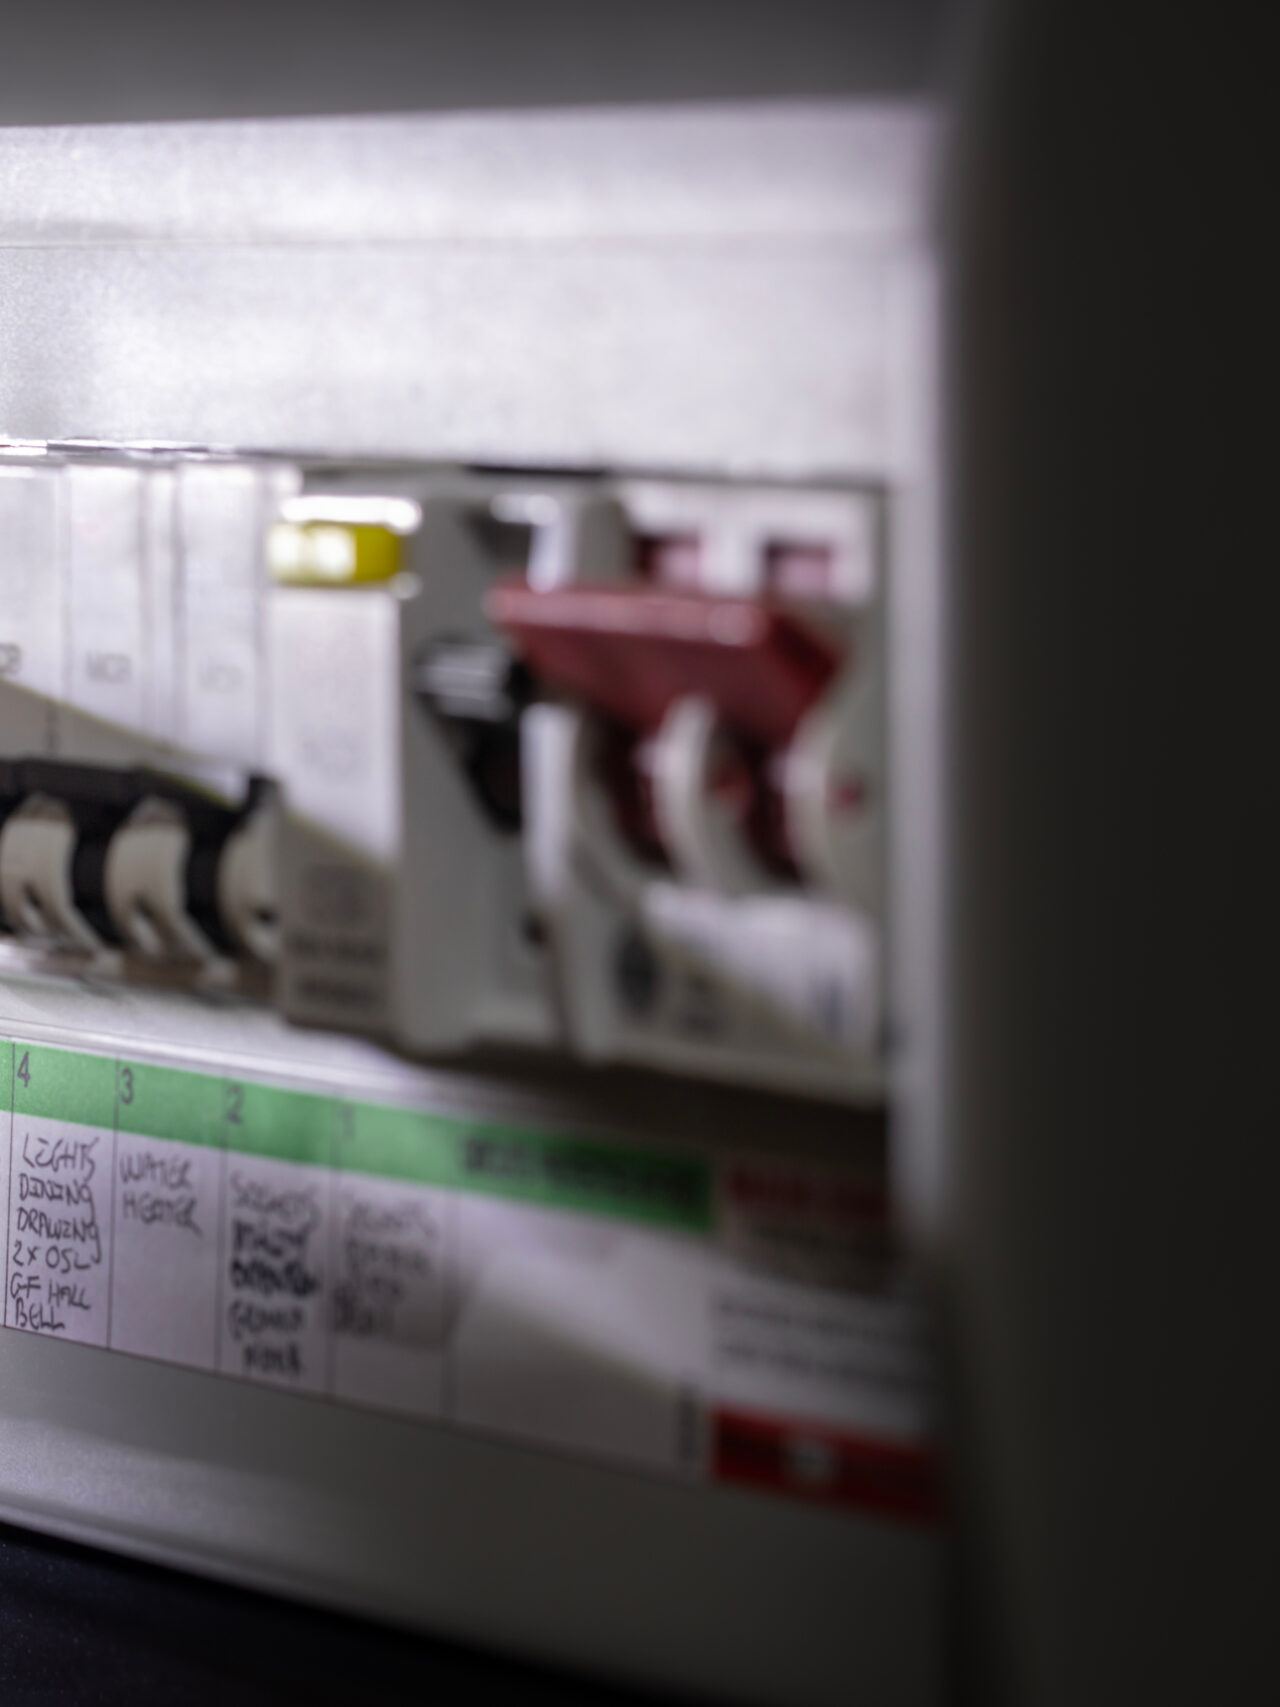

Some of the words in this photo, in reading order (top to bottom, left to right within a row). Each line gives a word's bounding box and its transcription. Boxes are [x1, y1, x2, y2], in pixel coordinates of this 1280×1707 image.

[17, 1050, 31, 1089] 4
[121, 1066, 135, 1105] 3
[226, 1084, 244, 1125] 2
[22, 1132, 100, 1184] LIGHTS
[19, 1173, 96, 1226] DINING
[17, 1206, 103, 1265] DRAWING
[15, 1296, 66, 1331] BELL
